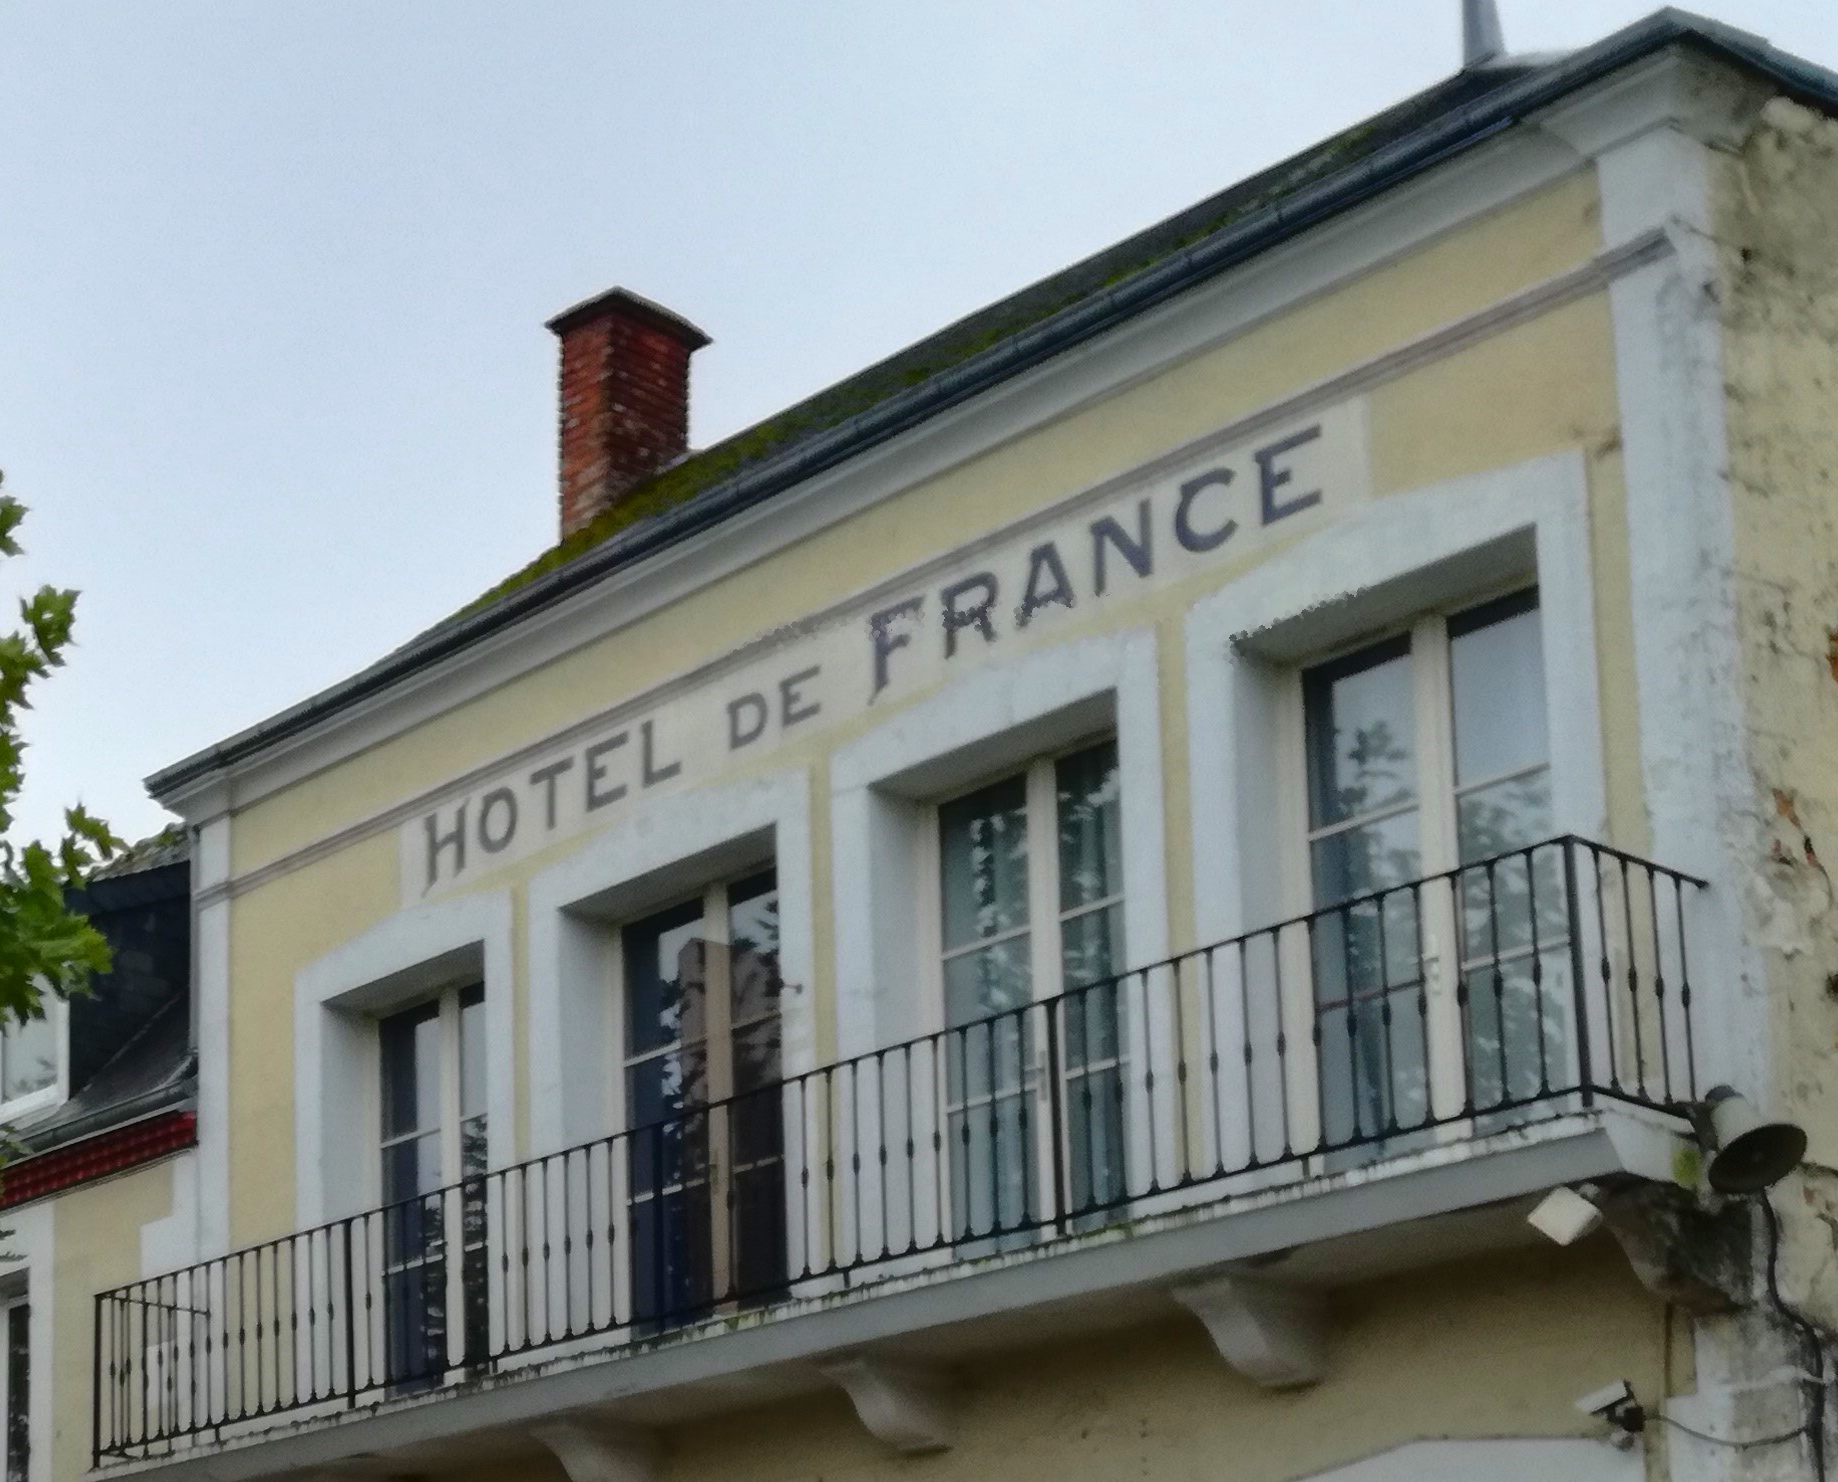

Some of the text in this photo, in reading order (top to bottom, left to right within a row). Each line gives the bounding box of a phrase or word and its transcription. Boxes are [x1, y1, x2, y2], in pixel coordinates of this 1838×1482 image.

[422, 424, 1323, 897] HOTEL DE FRANCE
